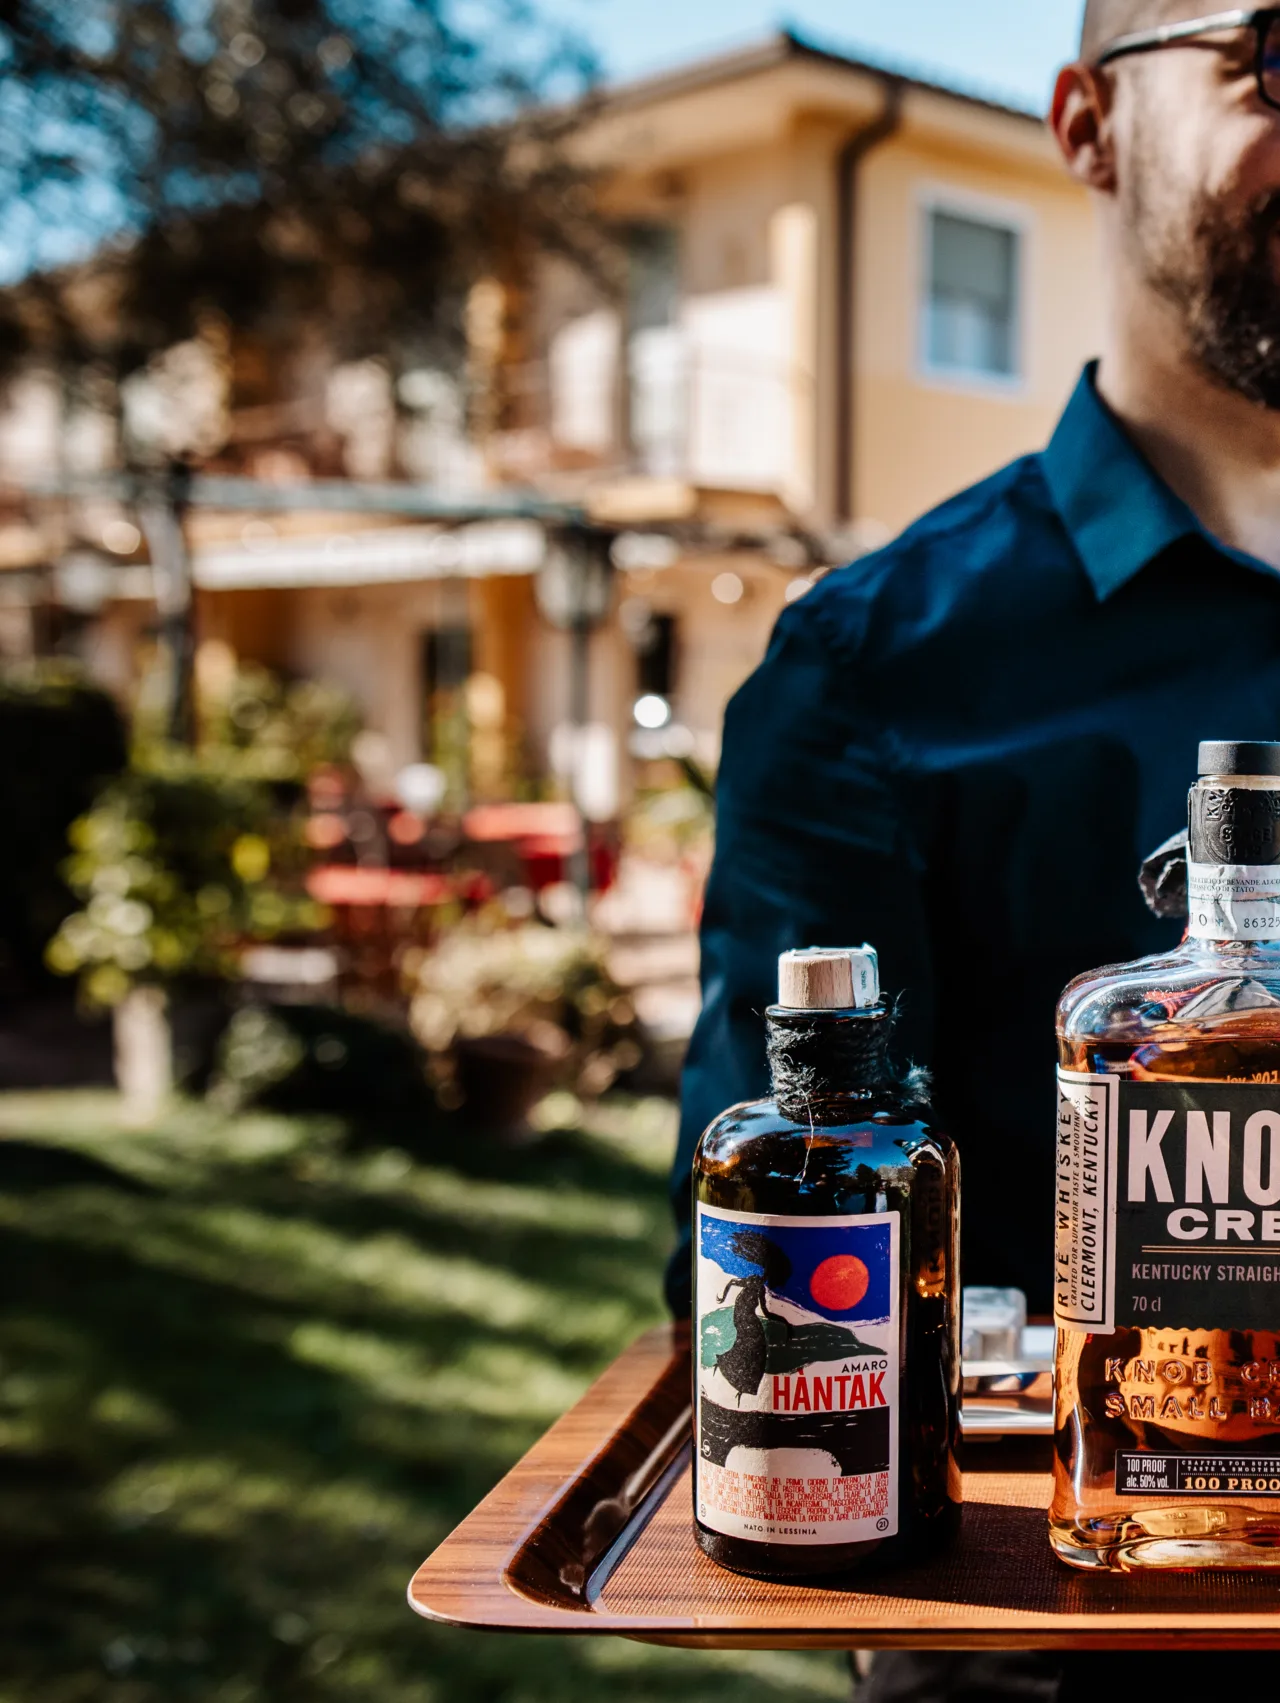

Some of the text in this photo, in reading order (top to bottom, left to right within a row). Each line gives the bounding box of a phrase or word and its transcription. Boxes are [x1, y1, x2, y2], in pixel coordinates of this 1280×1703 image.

[1226, 878, 1260, 886] BEVANDE
[1072, 1170, 1080, 1197] TASTE
[1057, 1091, 1072, 1308] RYE WHISKEY
[1081, 1095, 1099, 1312] CLERMONT, KENTUCKY
[1131, 1263, 1212, 1281] KENTUCKY
[1131, 1296, 1162, 1312] 70 cl
[841, 1359, 888, 1374] AMARO
[1104, 1357, 1214, 1385] KNOB
[1104, 1391, 1228, 1420] SMALL
[1126, 1458, 1168, 1473] 100 PROOF
[875, 1472, 888, 1480] LUNA
[1126, 1474, 1170, 1489] alc. 50% vol.
[1184, 1476, 1221, 1490] 100
[810, 1485, 828, 1493] SENZA
[844, 1482, 872, 1492] PRESENZA
[784, 1492, 794, 1500] PER
[797, 1492, 833, 1501] CONVERSARE
[777, 1513, 797, 1522] APPENA
[799, 1514, 806, 1522] LA
[809, 1514, 826, 1522] PORTA
[806, 1507, 831, 1515] PROPRIO
[744, 1523, 818, 1535] NATO IN LESSINIA
